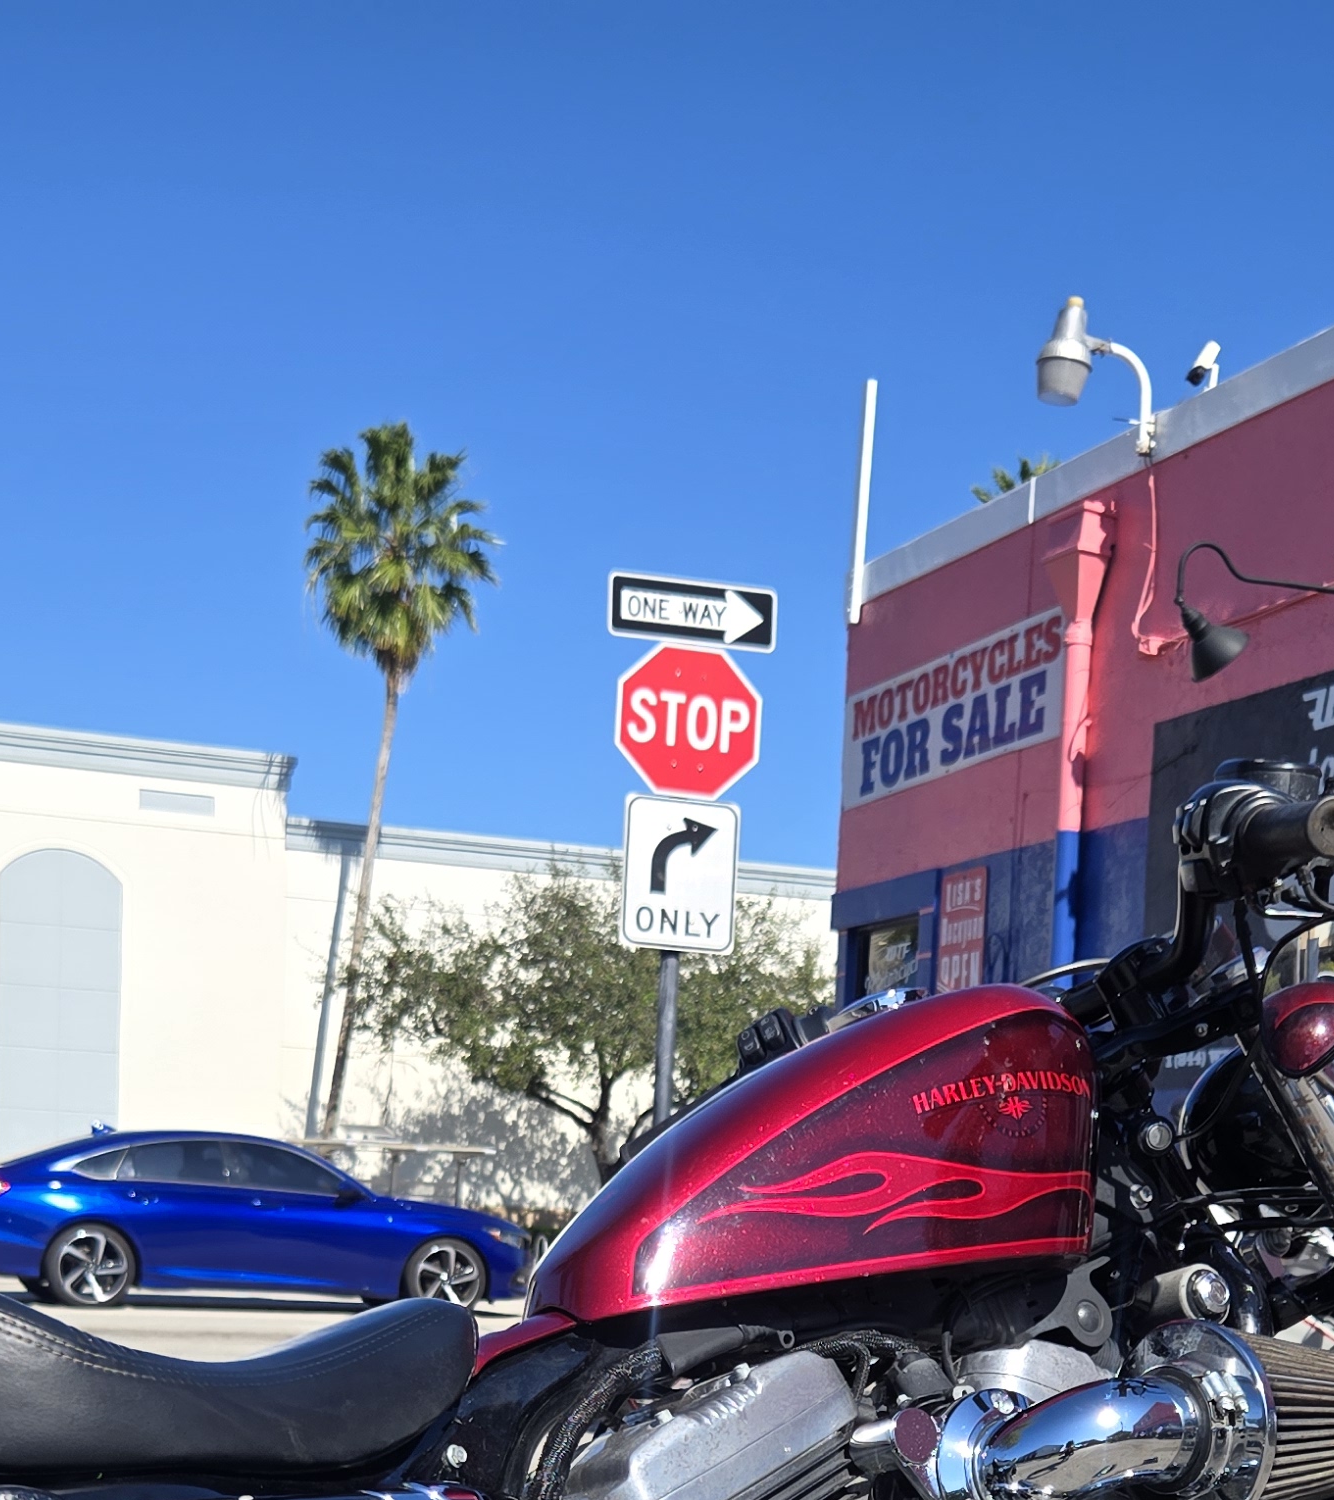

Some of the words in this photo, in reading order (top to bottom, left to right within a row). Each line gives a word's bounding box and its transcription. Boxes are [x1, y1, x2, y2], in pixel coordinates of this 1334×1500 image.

[627, 595, 670, 621] ONE
[682, 601, 728, 627] WAY
[852, 614, 1064, 742] MOTORCYCLES
[626, 687, 751, 754] STOP
[859, 717, 931, 798] FOR
[939, 670, 1048, 768] SALE
[636, 905, 720, 939] ONLY
[912, 1070, 1091, 1115] HARLEY-DAVIDSON
